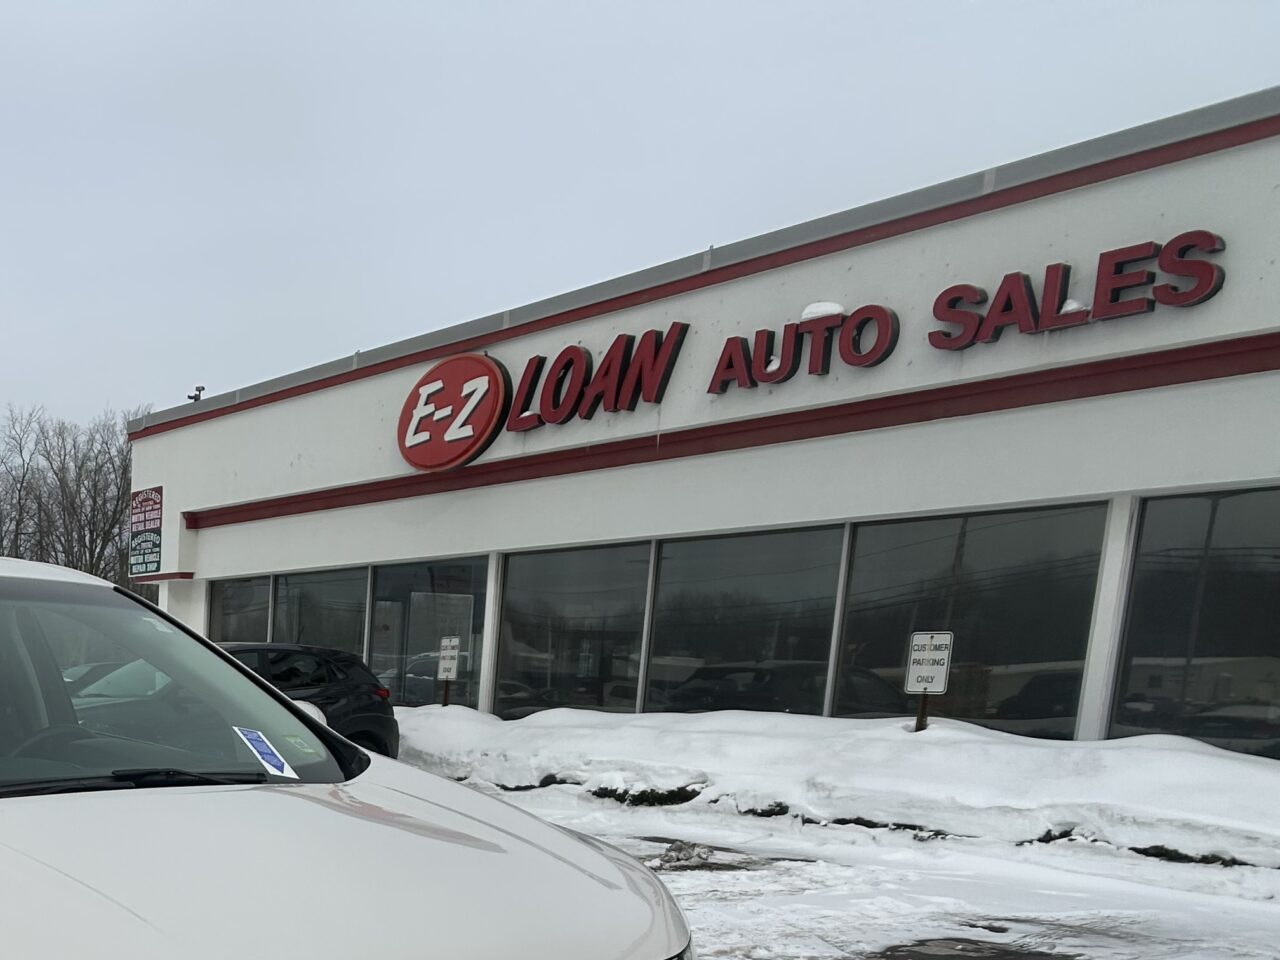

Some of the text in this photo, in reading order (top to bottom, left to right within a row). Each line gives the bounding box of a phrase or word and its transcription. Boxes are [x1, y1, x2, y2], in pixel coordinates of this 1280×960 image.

[405, 229, 1226, 447] E-Z LOAN AUTO SALES
[913, 644, 950, 652] CUSTOMER
[912, 658, 945, 666] PARKING
[916, 675, 935, 683] ONLY
